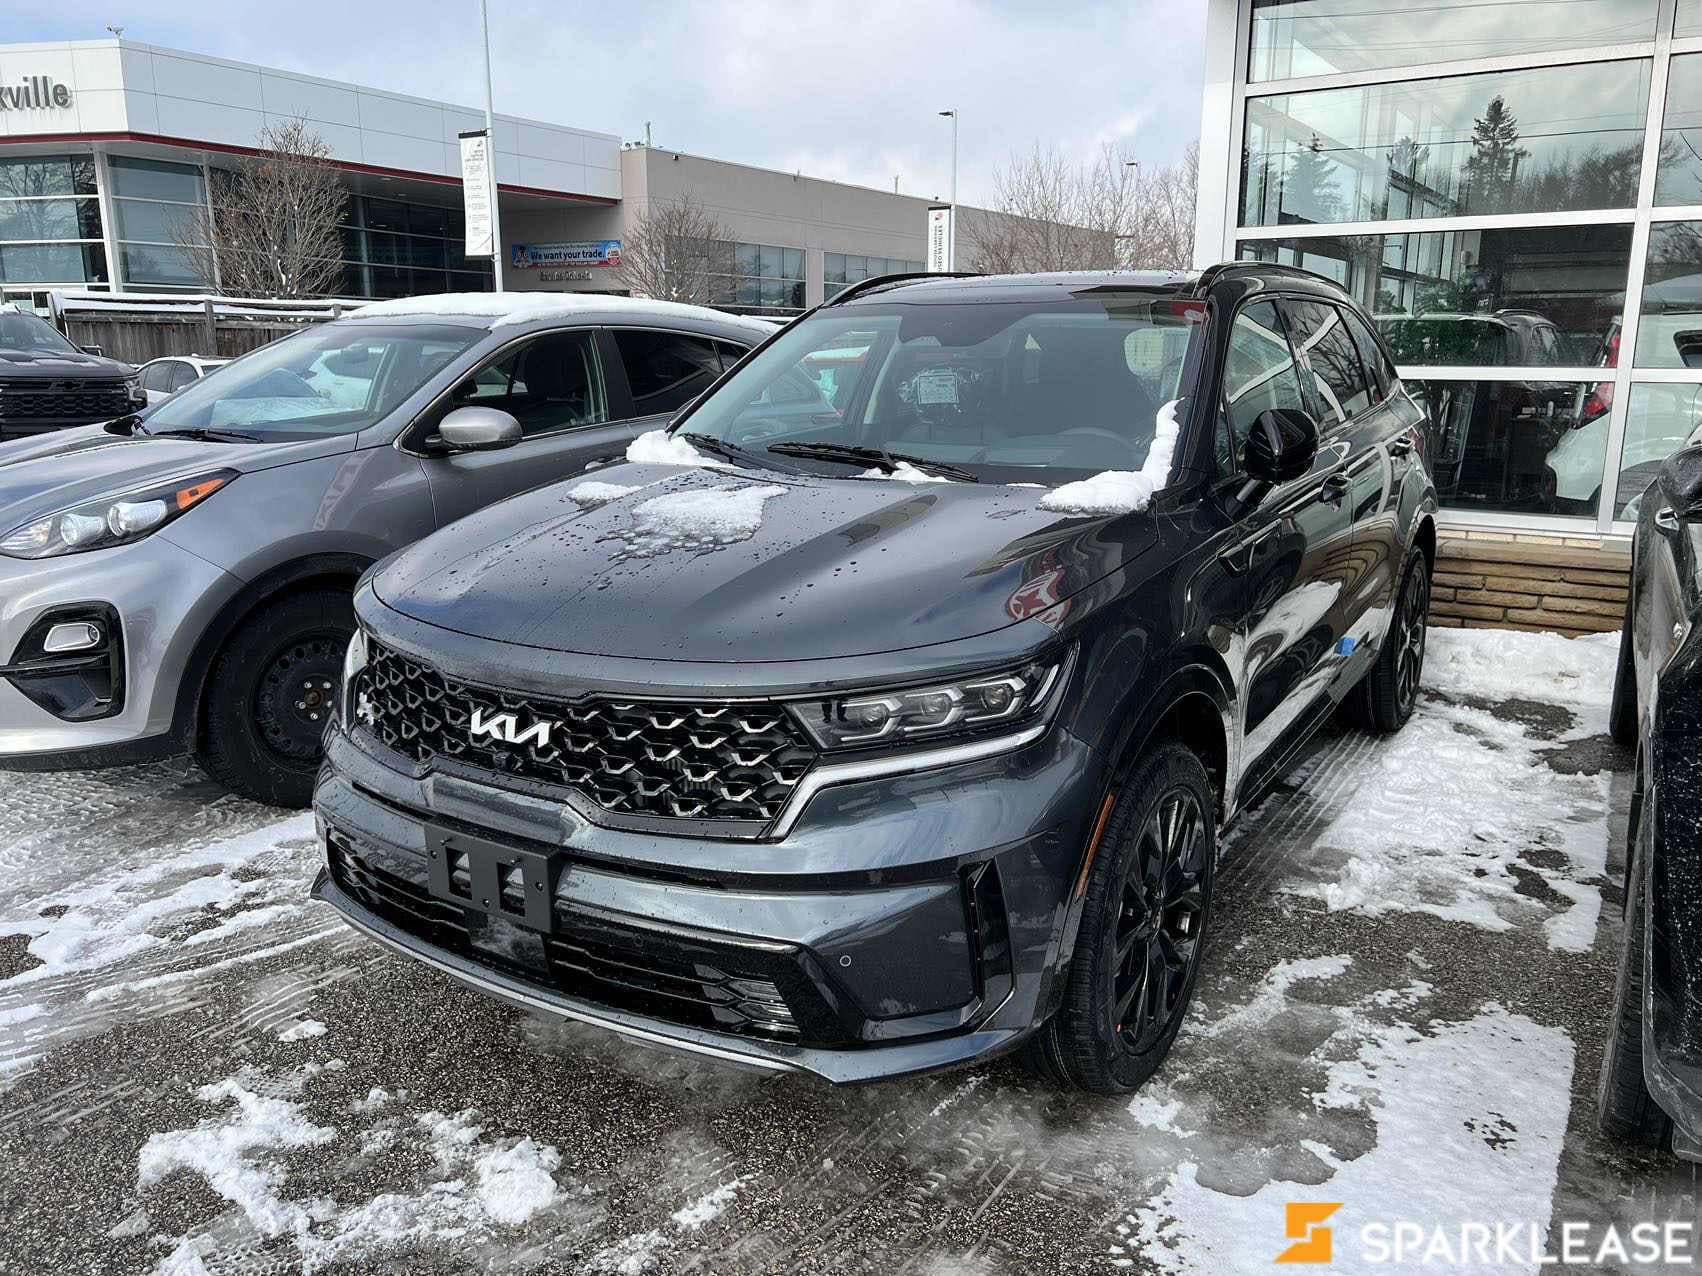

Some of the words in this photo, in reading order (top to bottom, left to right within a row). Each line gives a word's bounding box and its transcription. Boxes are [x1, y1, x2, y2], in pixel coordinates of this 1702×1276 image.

[531, 251, 542, 260] We
[543, 250, 562, 260] want
[563, 250, 581, 262] your
